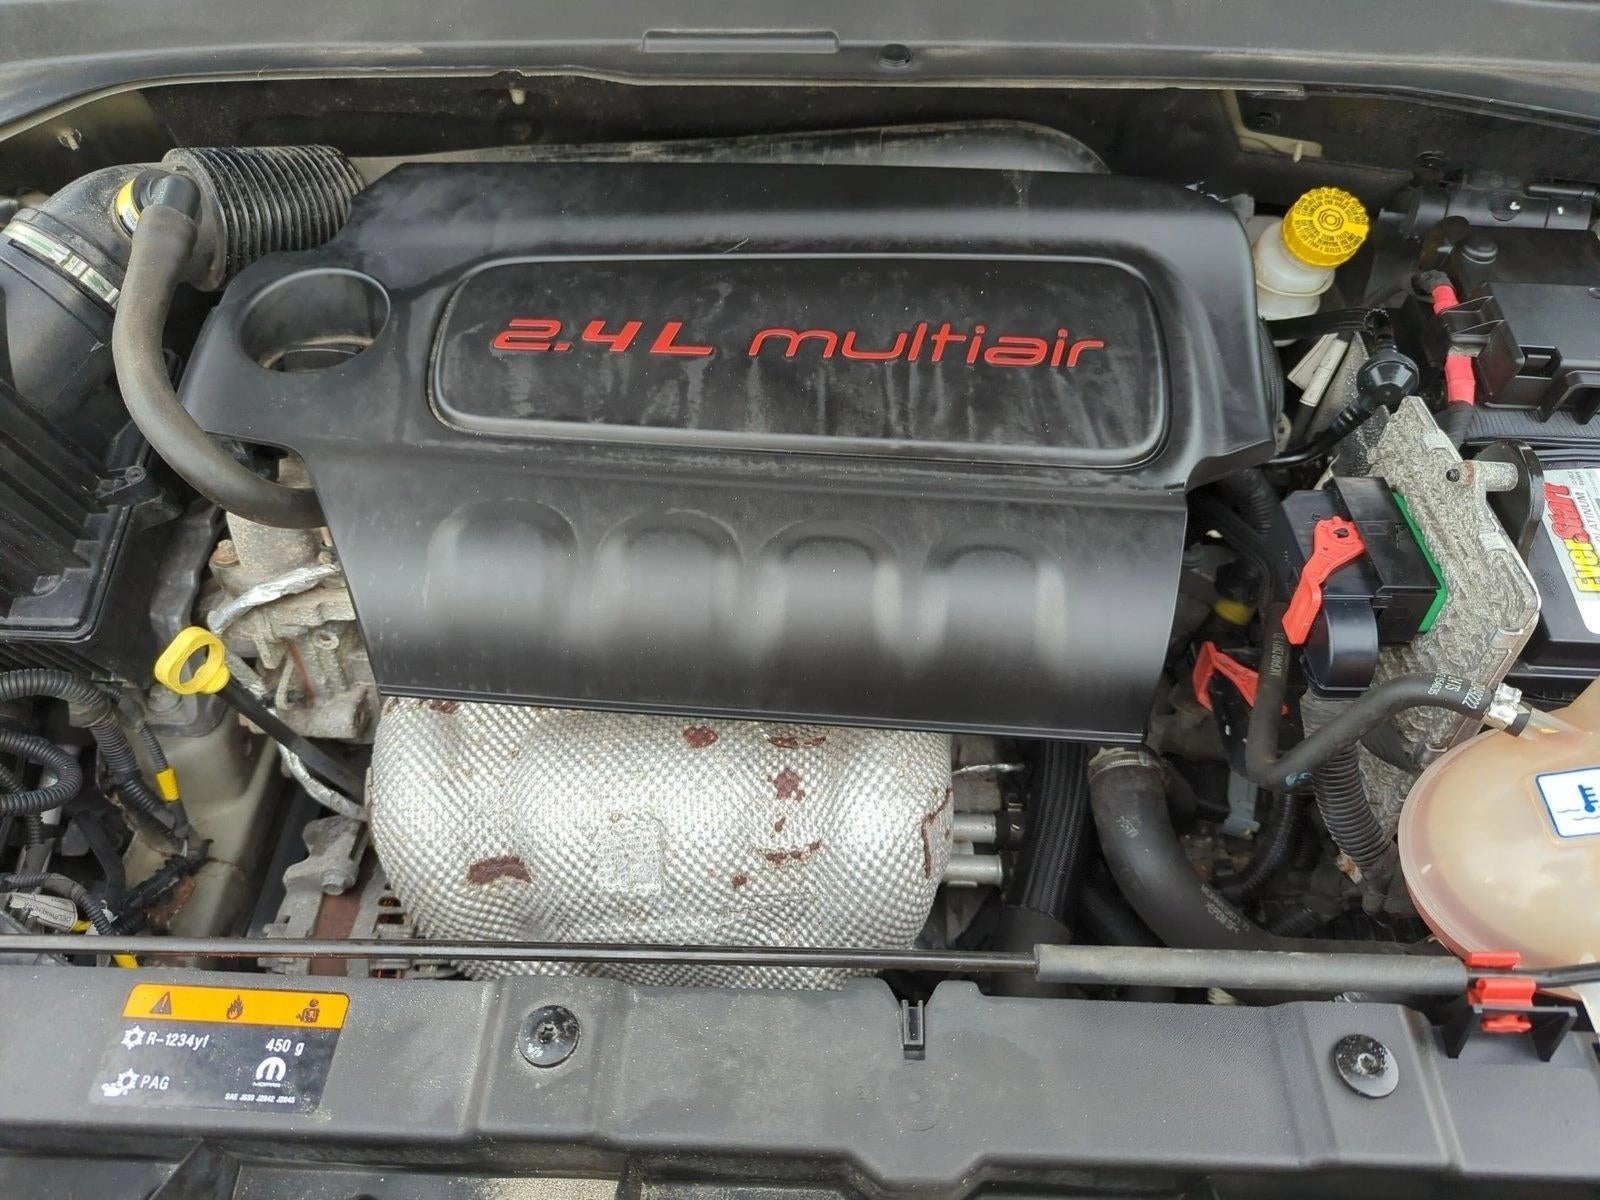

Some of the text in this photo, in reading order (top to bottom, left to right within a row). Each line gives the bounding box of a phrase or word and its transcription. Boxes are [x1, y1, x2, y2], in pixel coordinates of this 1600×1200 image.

[746, 321, 1105, 368] multiair
[147, 1033, 209, 1051] R-1234yf
[265, 1038, 305, 1056] 450 g
[139, 1075, 171, 1090] PAG
[224, 1092, 239, 1101] SAE
